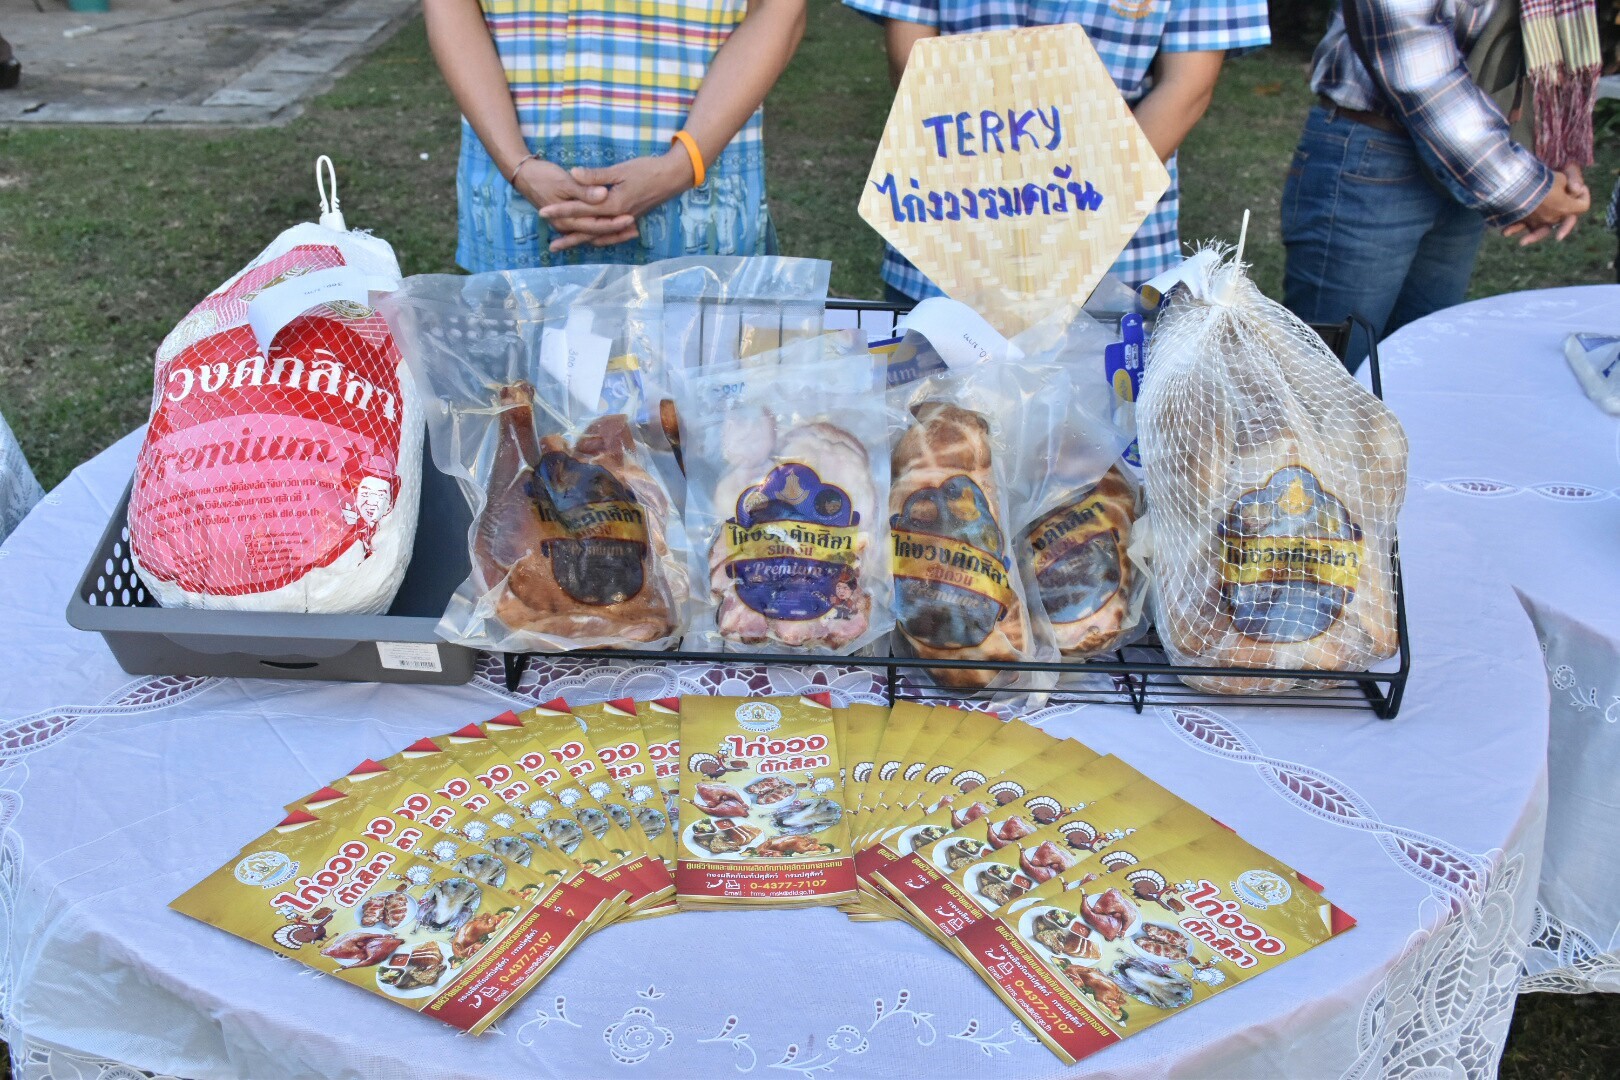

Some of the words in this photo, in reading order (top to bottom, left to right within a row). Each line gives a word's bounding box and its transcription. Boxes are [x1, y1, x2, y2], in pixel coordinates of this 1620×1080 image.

[921, 105, 1062, 158] TERKY
[870, 164, 1104, 222] ไก่งวงรมควัน
[728, 735, 826, 758] ไก่งวง
[760, 755, 828, 773] ตักสิลา
[273, 842, 366, 911] ไก่งวง
[338, 853, 396, 905] ตักสิลา
[750, 879, 827, 891] 0-4377-7107
[1182, 918, 1259, 968] ตักสิลา
[1185, 881, 1283, 955] ไก่งวง
[499, 931, 552, 984] 0-4377-7107
[1014, 979, 1075, 1036] 0-4377-7107
